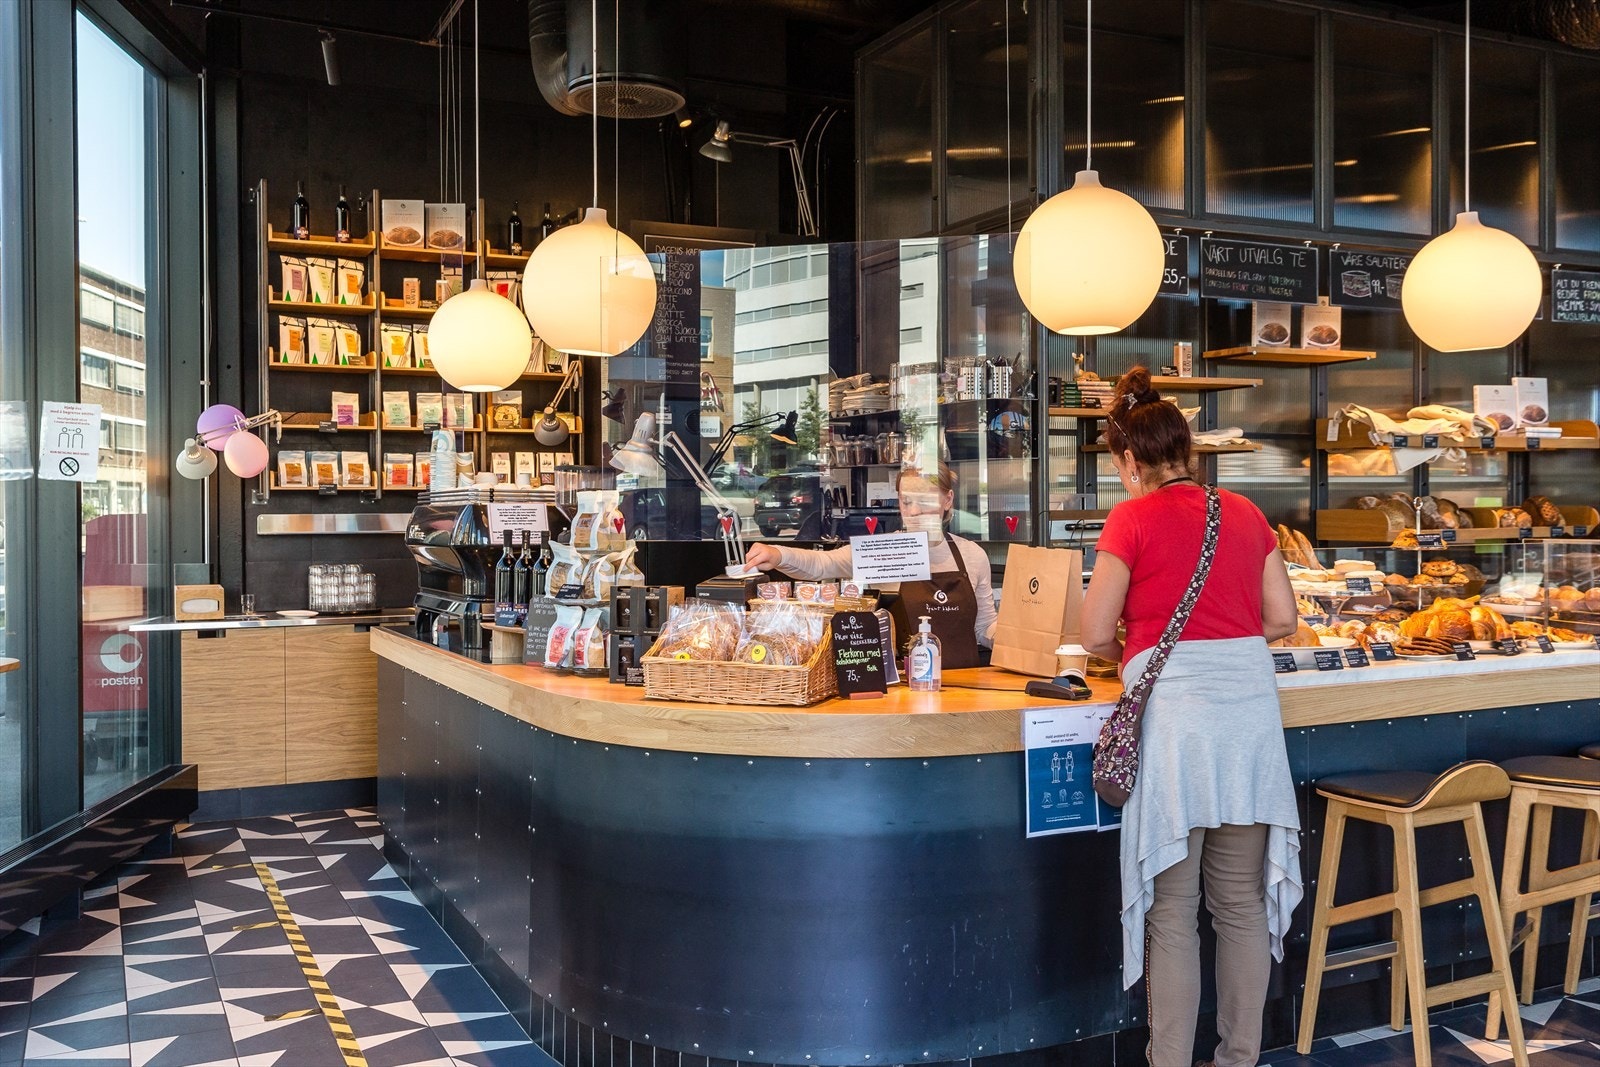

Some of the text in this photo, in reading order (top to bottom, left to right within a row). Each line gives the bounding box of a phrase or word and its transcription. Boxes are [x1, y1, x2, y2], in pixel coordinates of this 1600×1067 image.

[1204, 245, 1307, 268] VÅRT UTVALG TE
[1341, 251, 1407, 269] VÅRE SALATER
[101, 676, 143, 688] posten
[846, 670, 861, 682] 75,-
